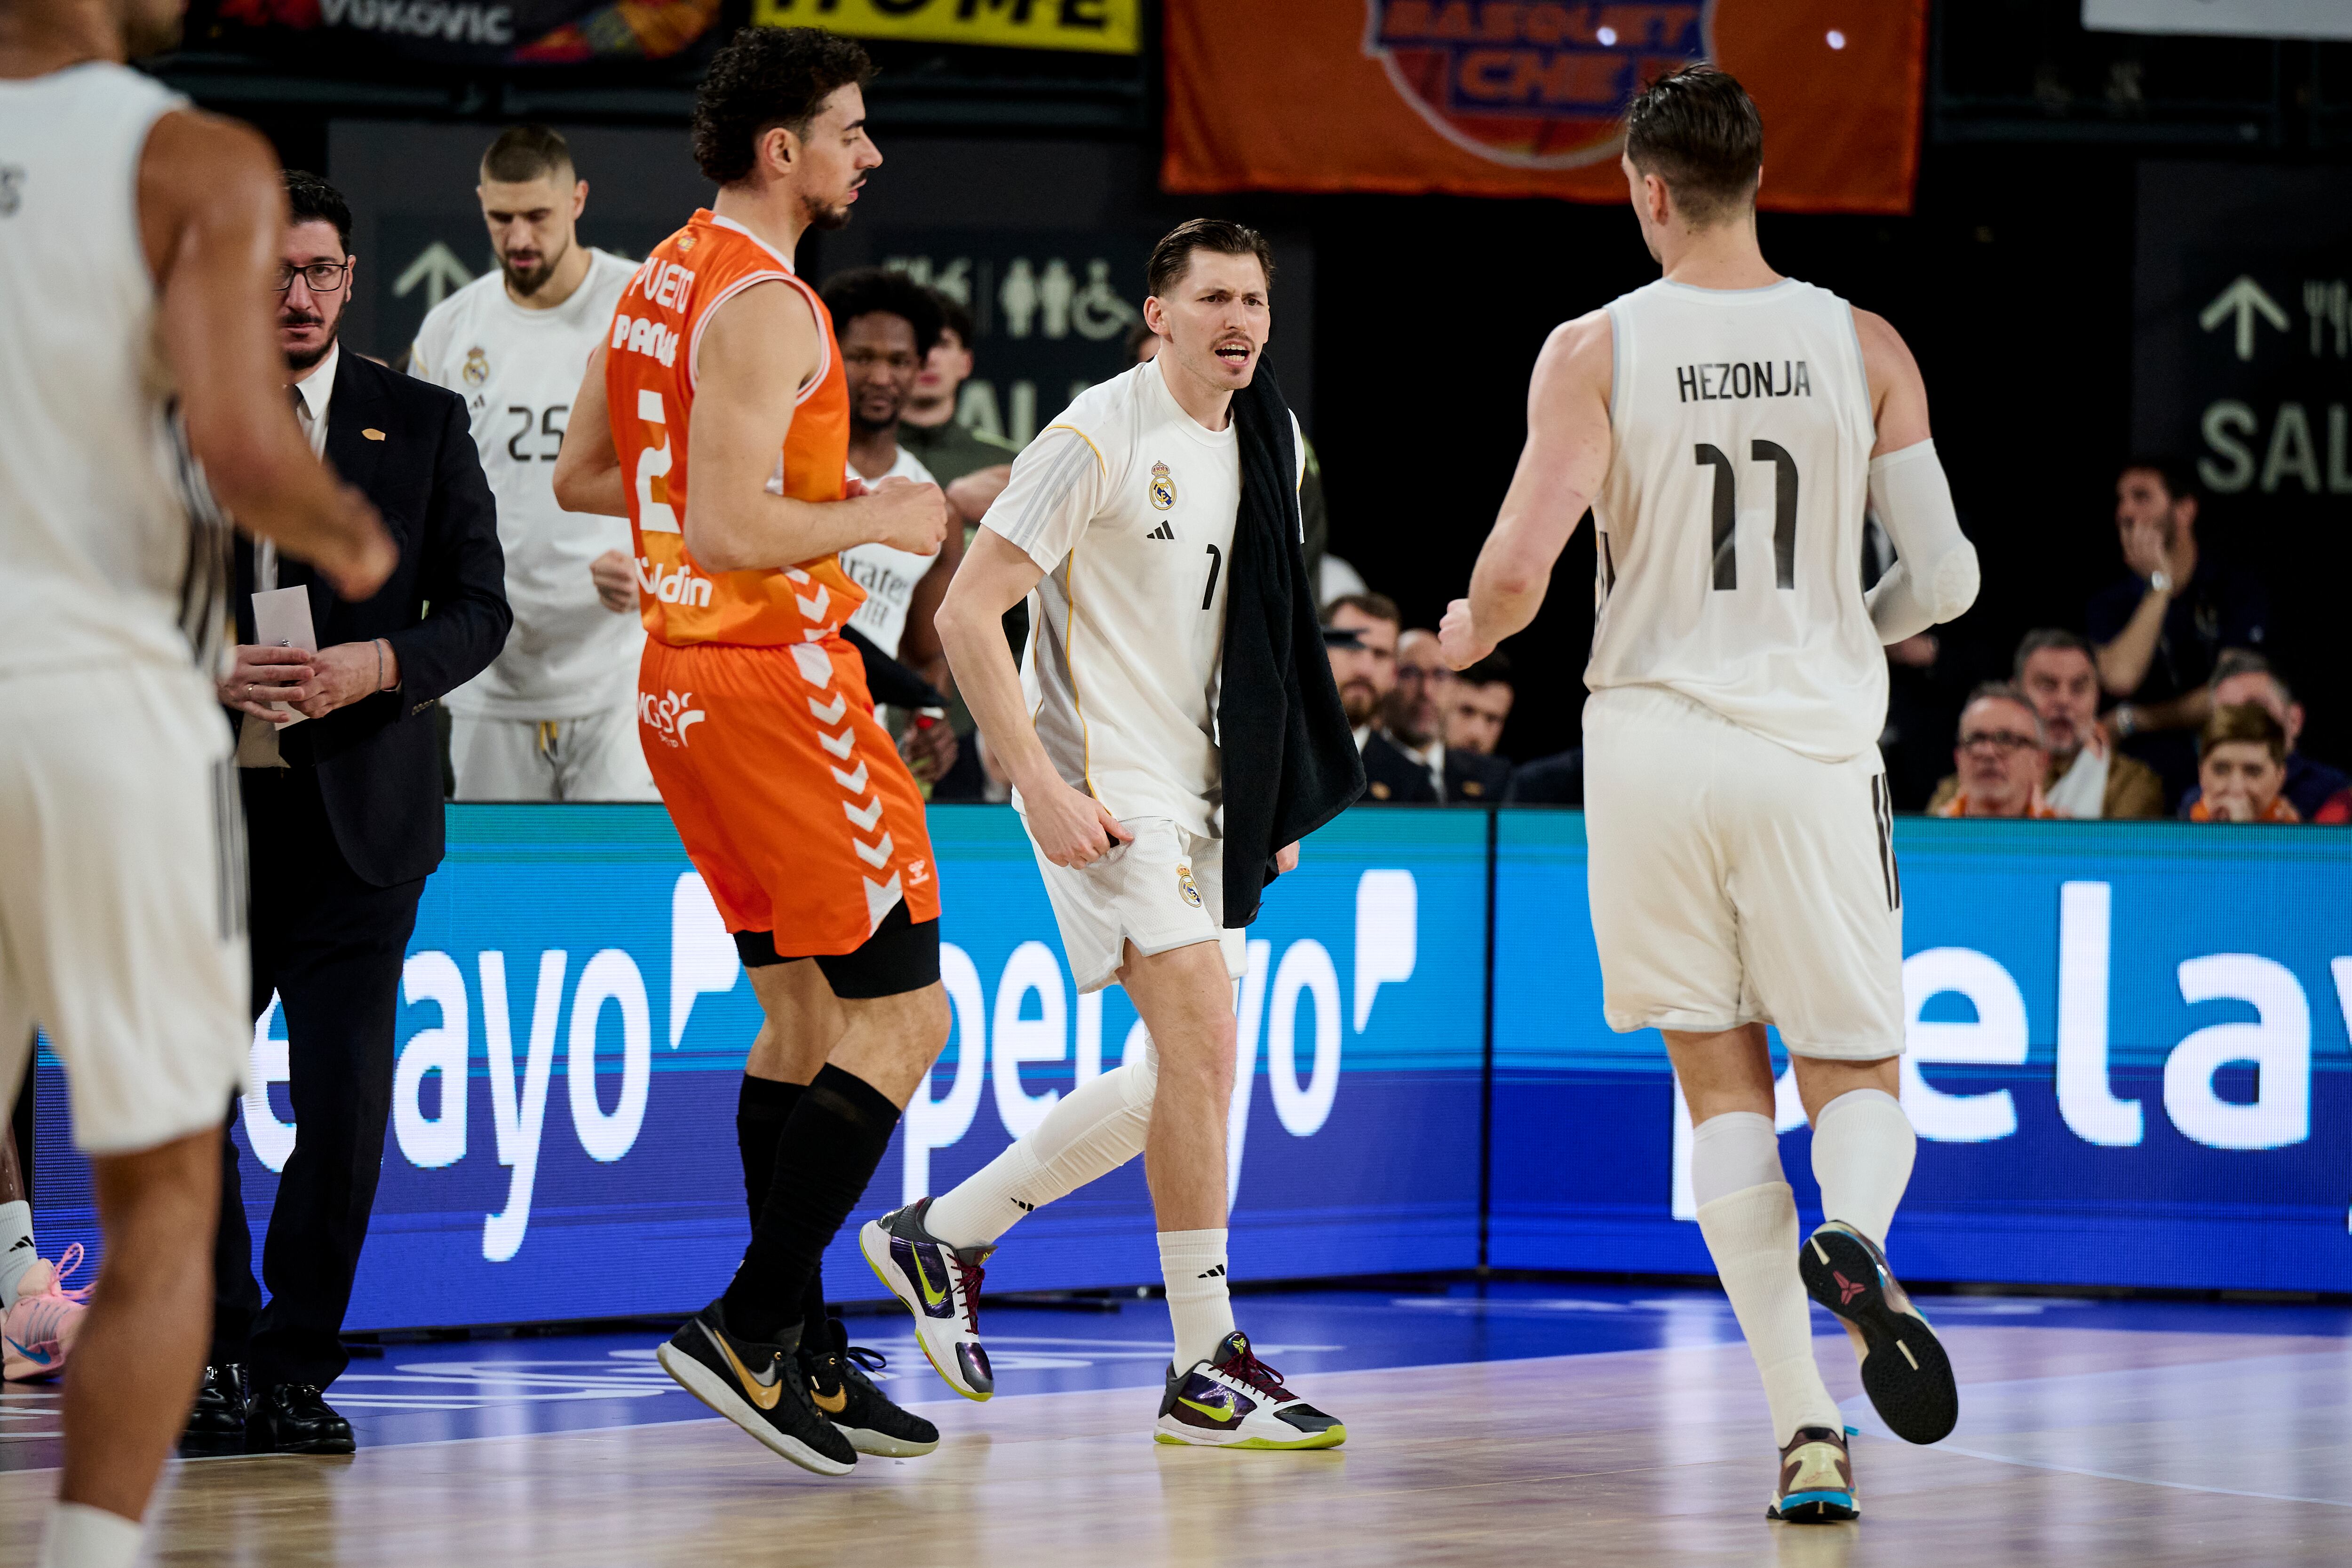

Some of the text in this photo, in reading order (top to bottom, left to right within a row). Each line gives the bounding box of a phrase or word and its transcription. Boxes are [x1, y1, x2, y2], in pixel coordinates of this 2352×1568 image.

[1677, 361, 1811, 403] HEZONJA
[508, 405, 569, 462] 25
[1694, 439, 1799, 591] 11
